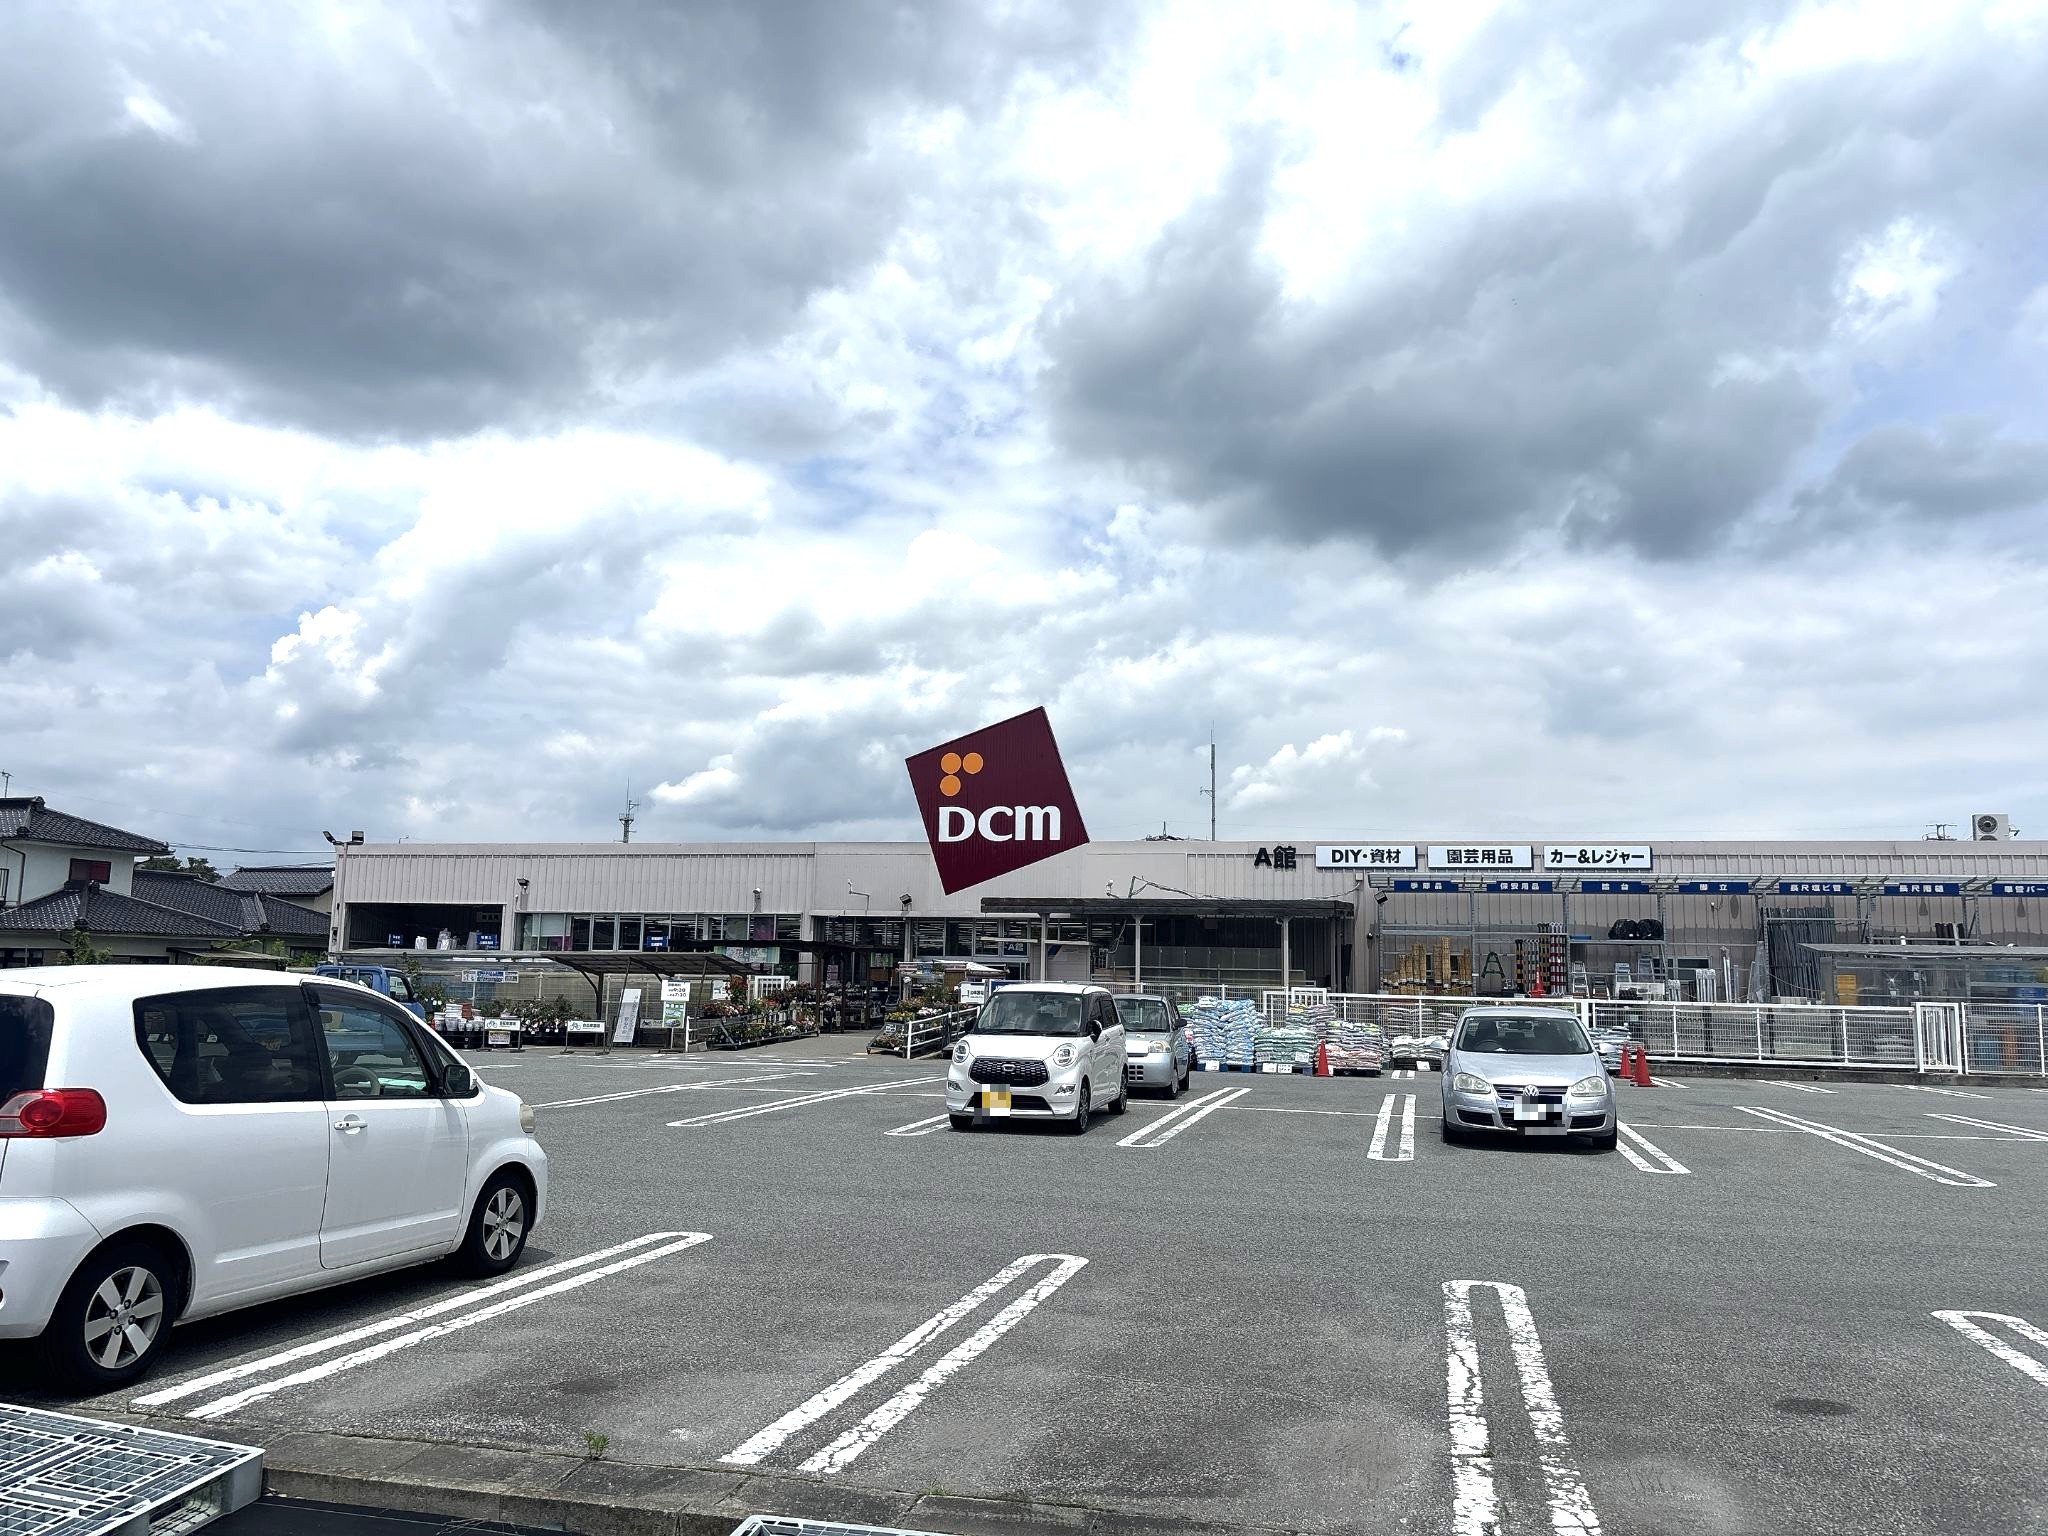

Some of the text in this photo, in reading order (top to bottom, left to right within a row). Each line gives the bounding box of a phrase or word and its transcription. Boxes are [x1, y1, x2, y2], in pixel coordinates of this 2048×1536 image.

[1254, 845, 1297, 869] A館
[1446, 848, 1513, 864] 園芸用品
[1550, 848, 1645, 864] カー&レジャー
[1499, 882, 1540, 890] 保安用品
[1790, 884, 1841, 892] 長尺塩ビ管
